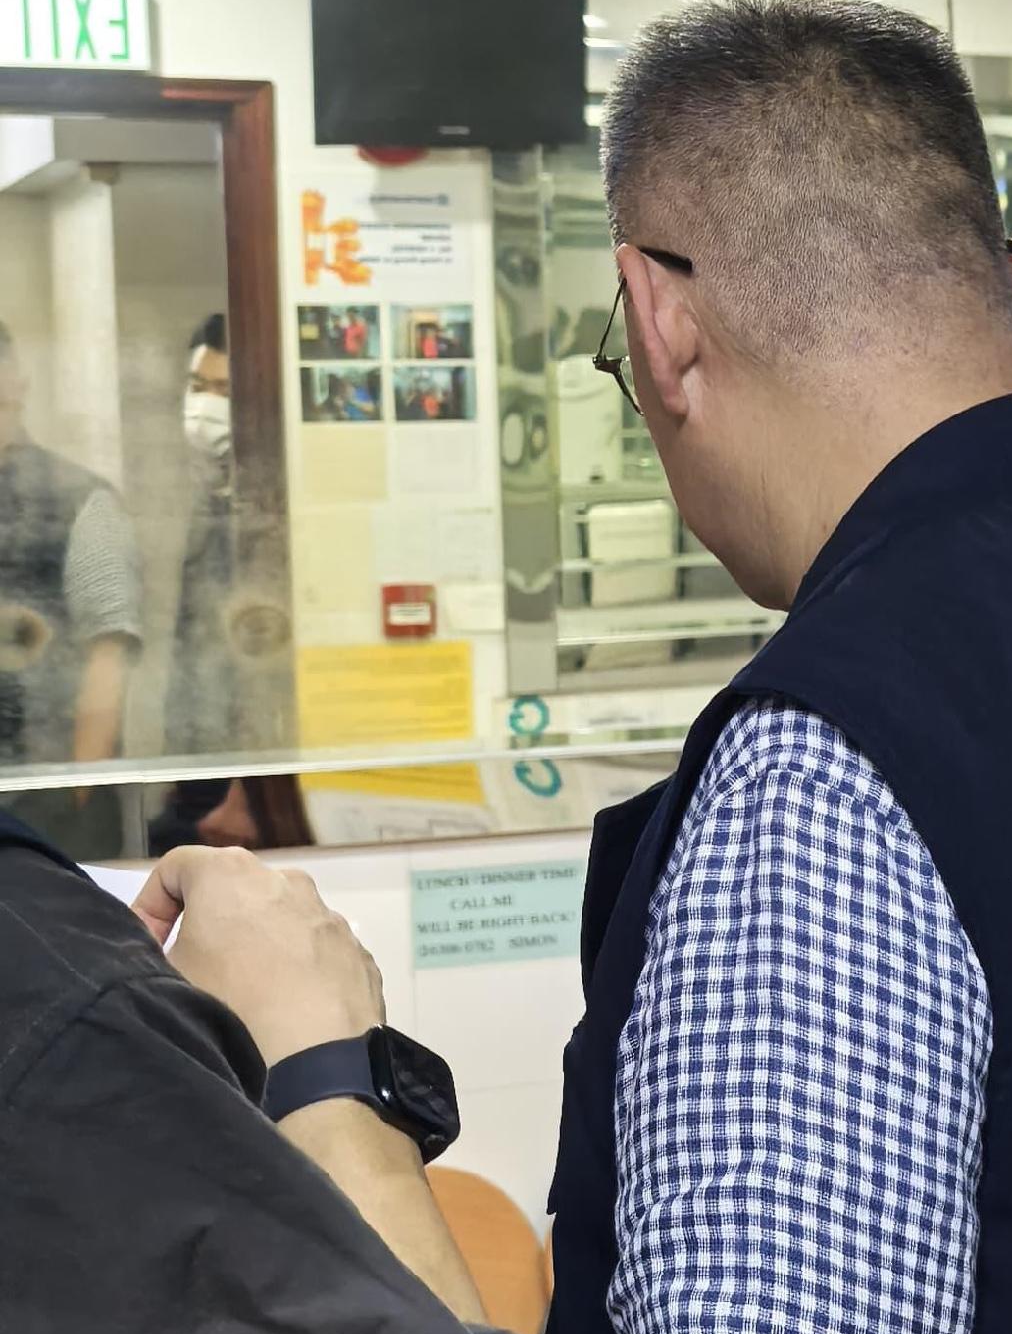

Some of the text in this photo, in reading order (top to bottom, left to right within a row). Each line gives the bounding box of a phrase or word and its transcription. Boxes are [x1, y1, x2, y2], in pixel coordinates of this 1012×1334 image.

[451, 897, 487, 911] CALL
[417, 921, 452, 934] WILL
[481, 915, 526, 930] RIGHT
